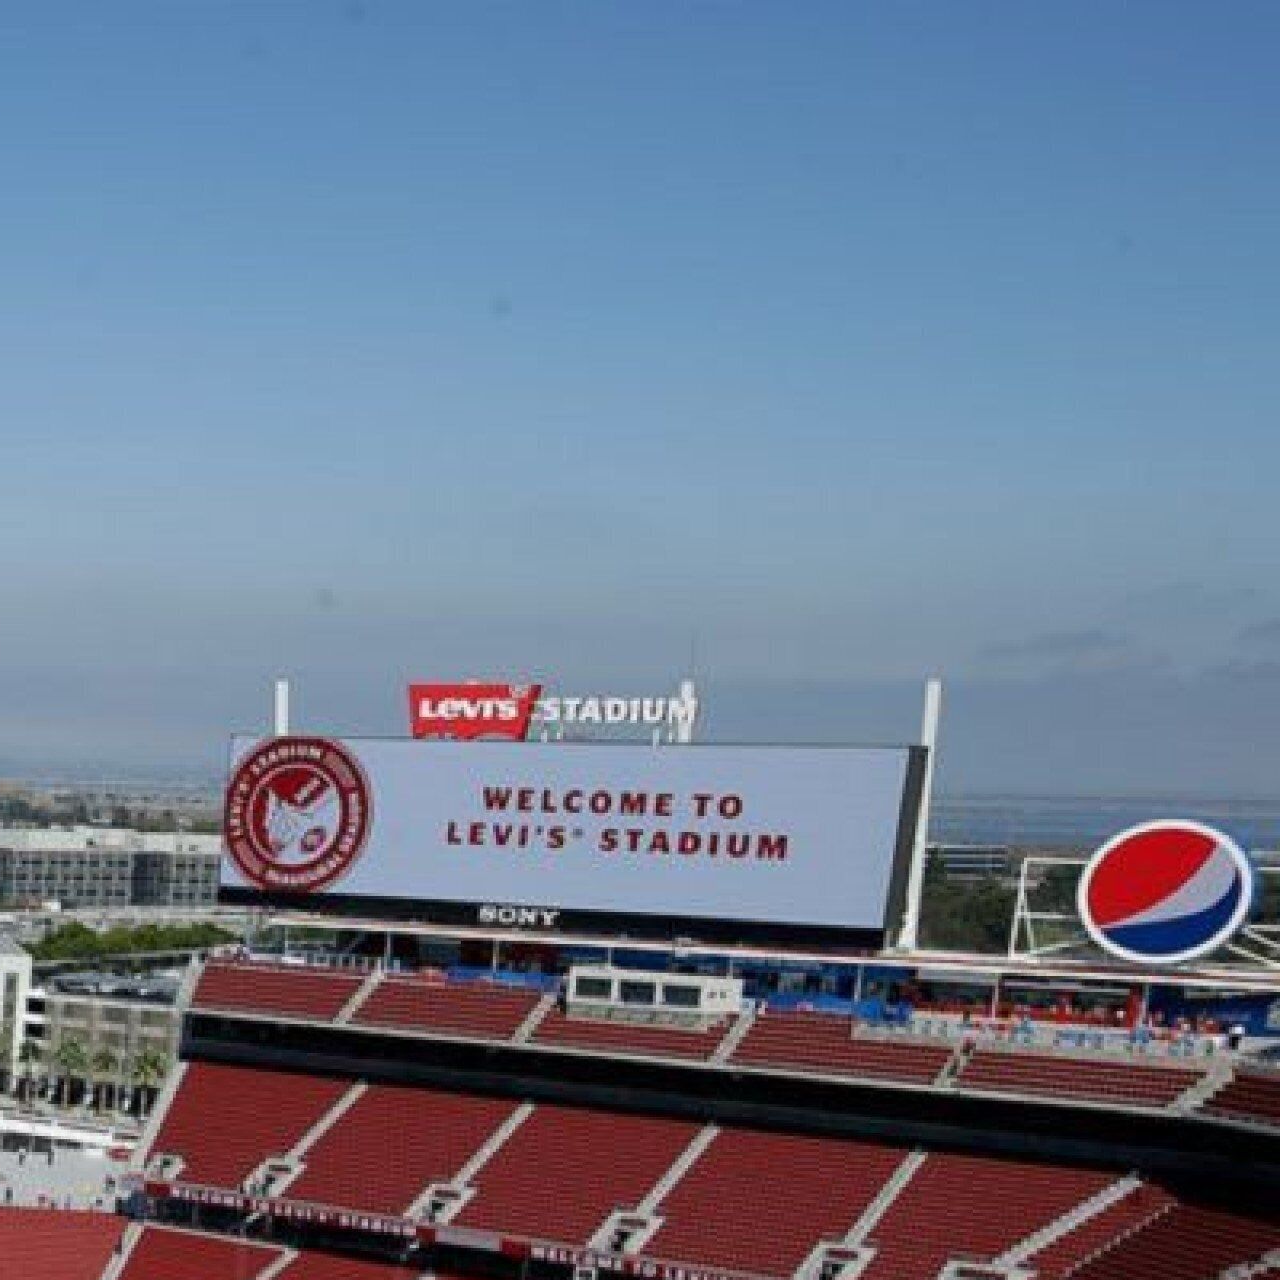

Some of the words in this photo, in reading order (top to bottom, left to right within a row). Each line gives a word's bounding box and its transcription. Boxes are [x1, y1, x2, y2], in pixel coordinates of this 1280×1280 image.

[542, 696, 697, 723] STADIUM
[482, 786, 675, 818] WELCOME
[692, 793, 744, 820] TO
[597, 828, 789, 861] STADIUM
[478, 904, 561, 926] SONY
